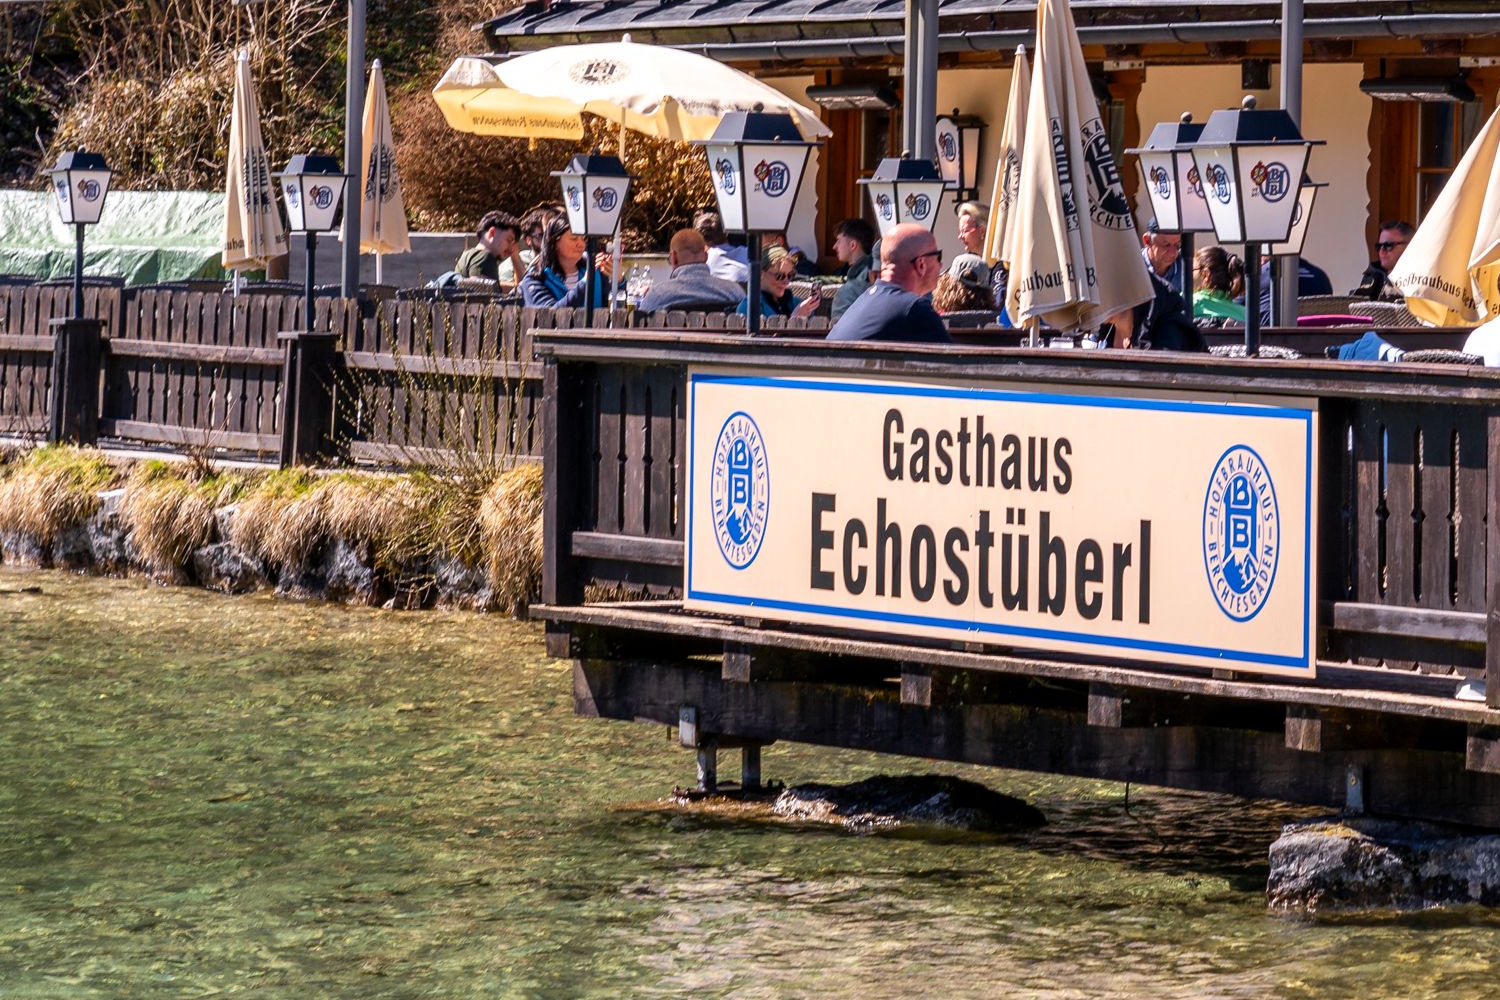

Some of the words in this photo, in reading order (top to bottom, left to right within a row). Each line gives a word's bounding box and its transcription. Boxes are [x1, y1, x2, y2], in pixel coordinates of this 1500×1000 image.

[715, 419, 765, 479] HOFBRAUHAUS
[883, 408, 1073, 494] Gasthaus
[1209, 454, 1274, 522] HOFBRAUHAUS
[715, 498, 765, 562] BERCHTESGADEN
[810, 493, 1151, 625] Echostüberl
[1208, 542, 1274, 613] BERCHTESGADEN
